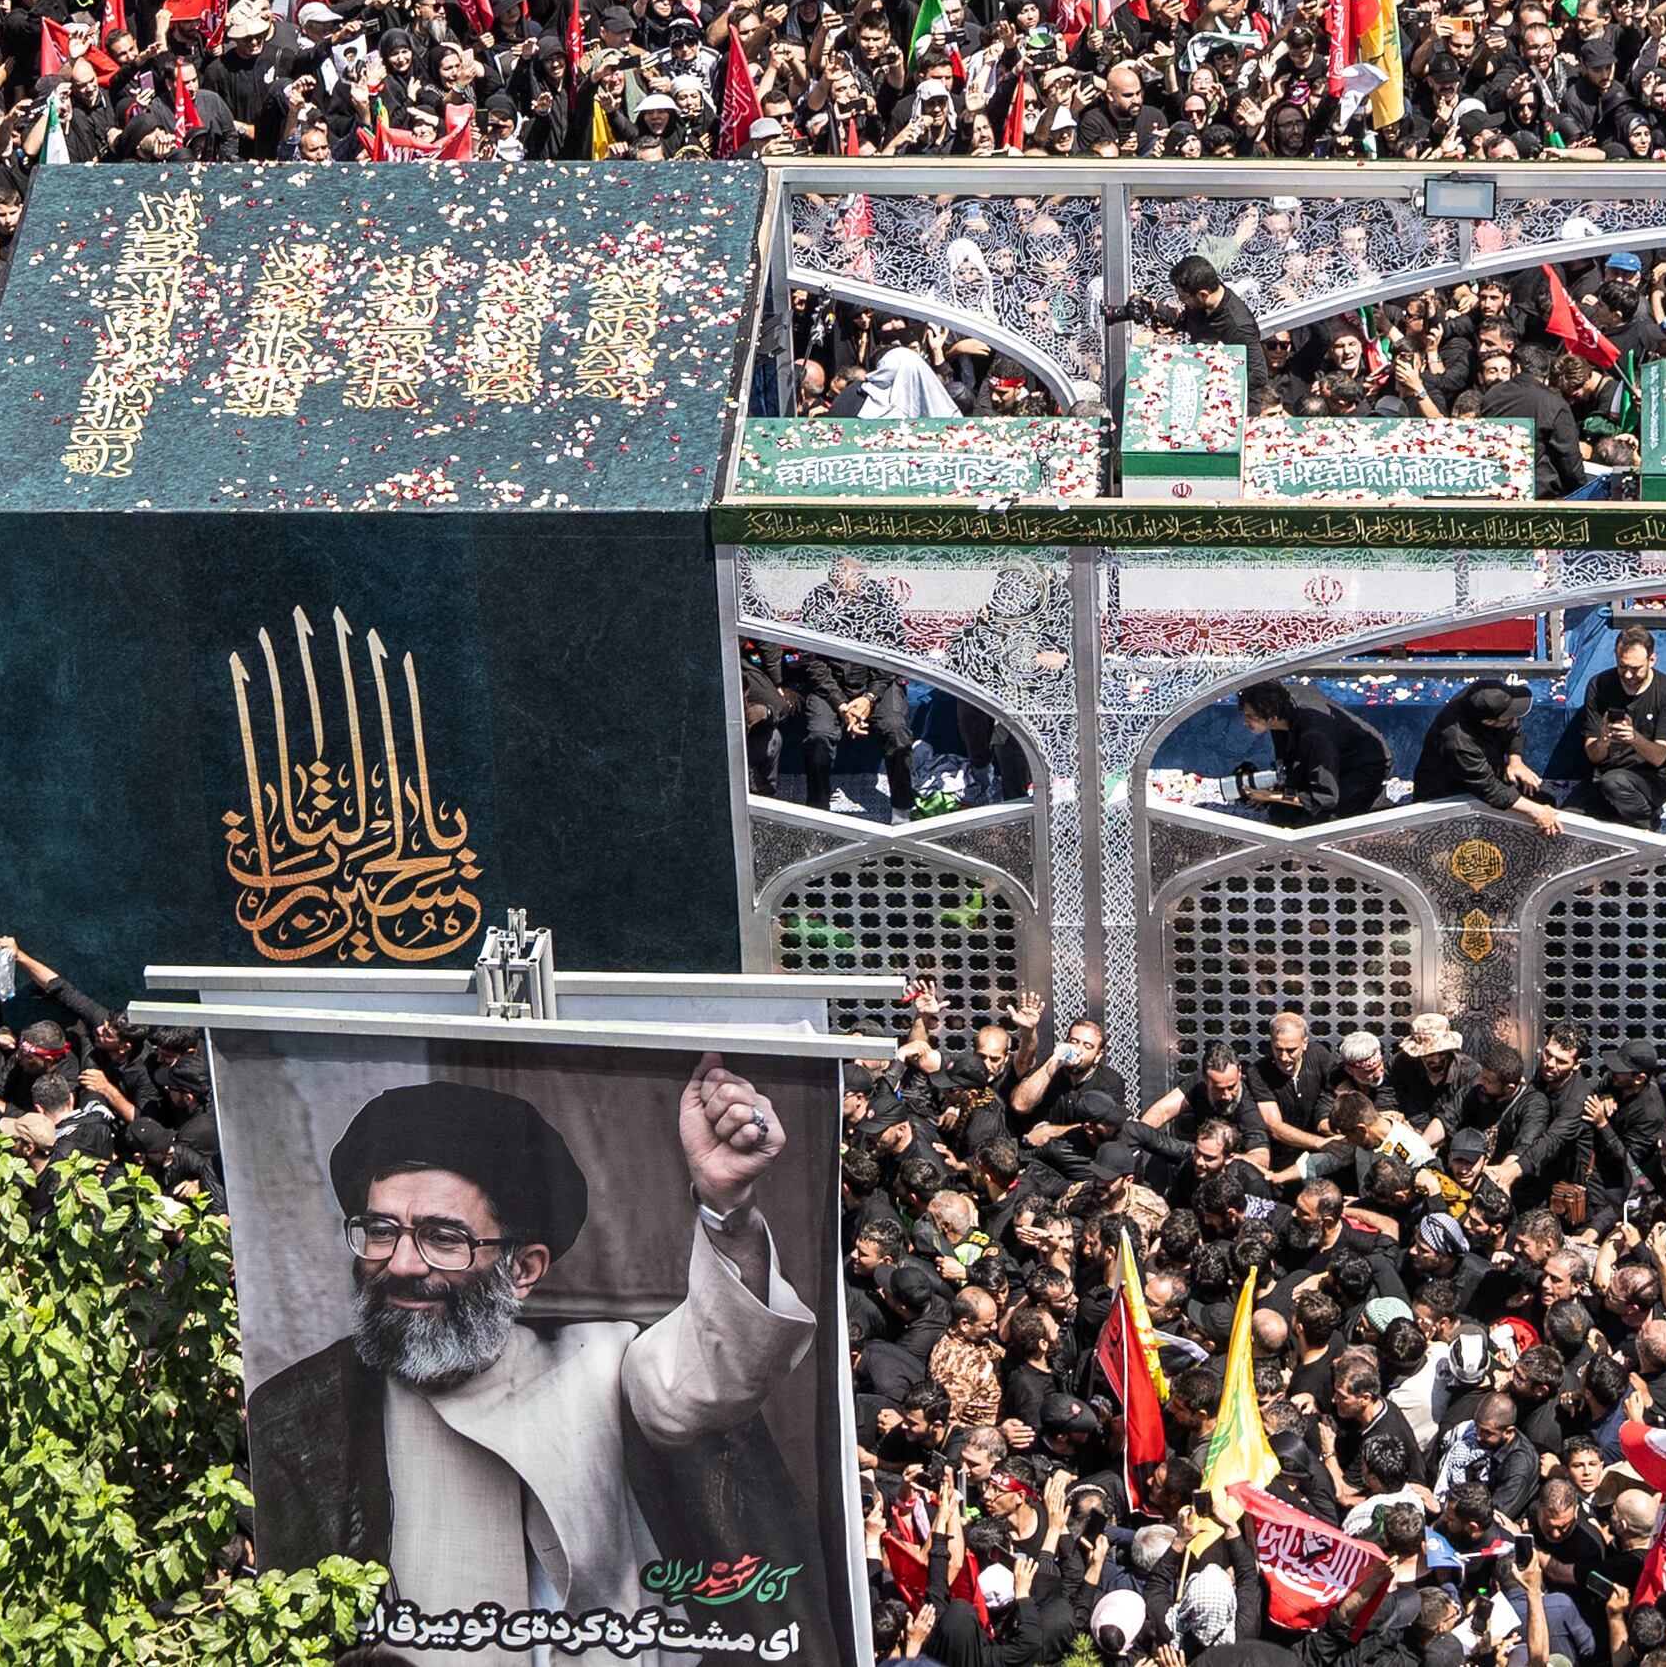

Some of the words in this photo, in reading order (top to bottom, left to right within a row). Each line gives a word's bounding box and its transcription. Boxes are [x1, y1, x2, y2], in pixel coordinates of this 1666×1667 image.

[645, 1558, 704, 1602] ایران
[692, 1562, 804, 1606] آقای
[693, 1554, 762, 1597] شهید
[388, 1605, 460, 1645] بیرق
[461, 1607, 497, 1646] تو
[658, 1619, 755, 1652] مشت
[758, 1620, 800, 1661] ای
